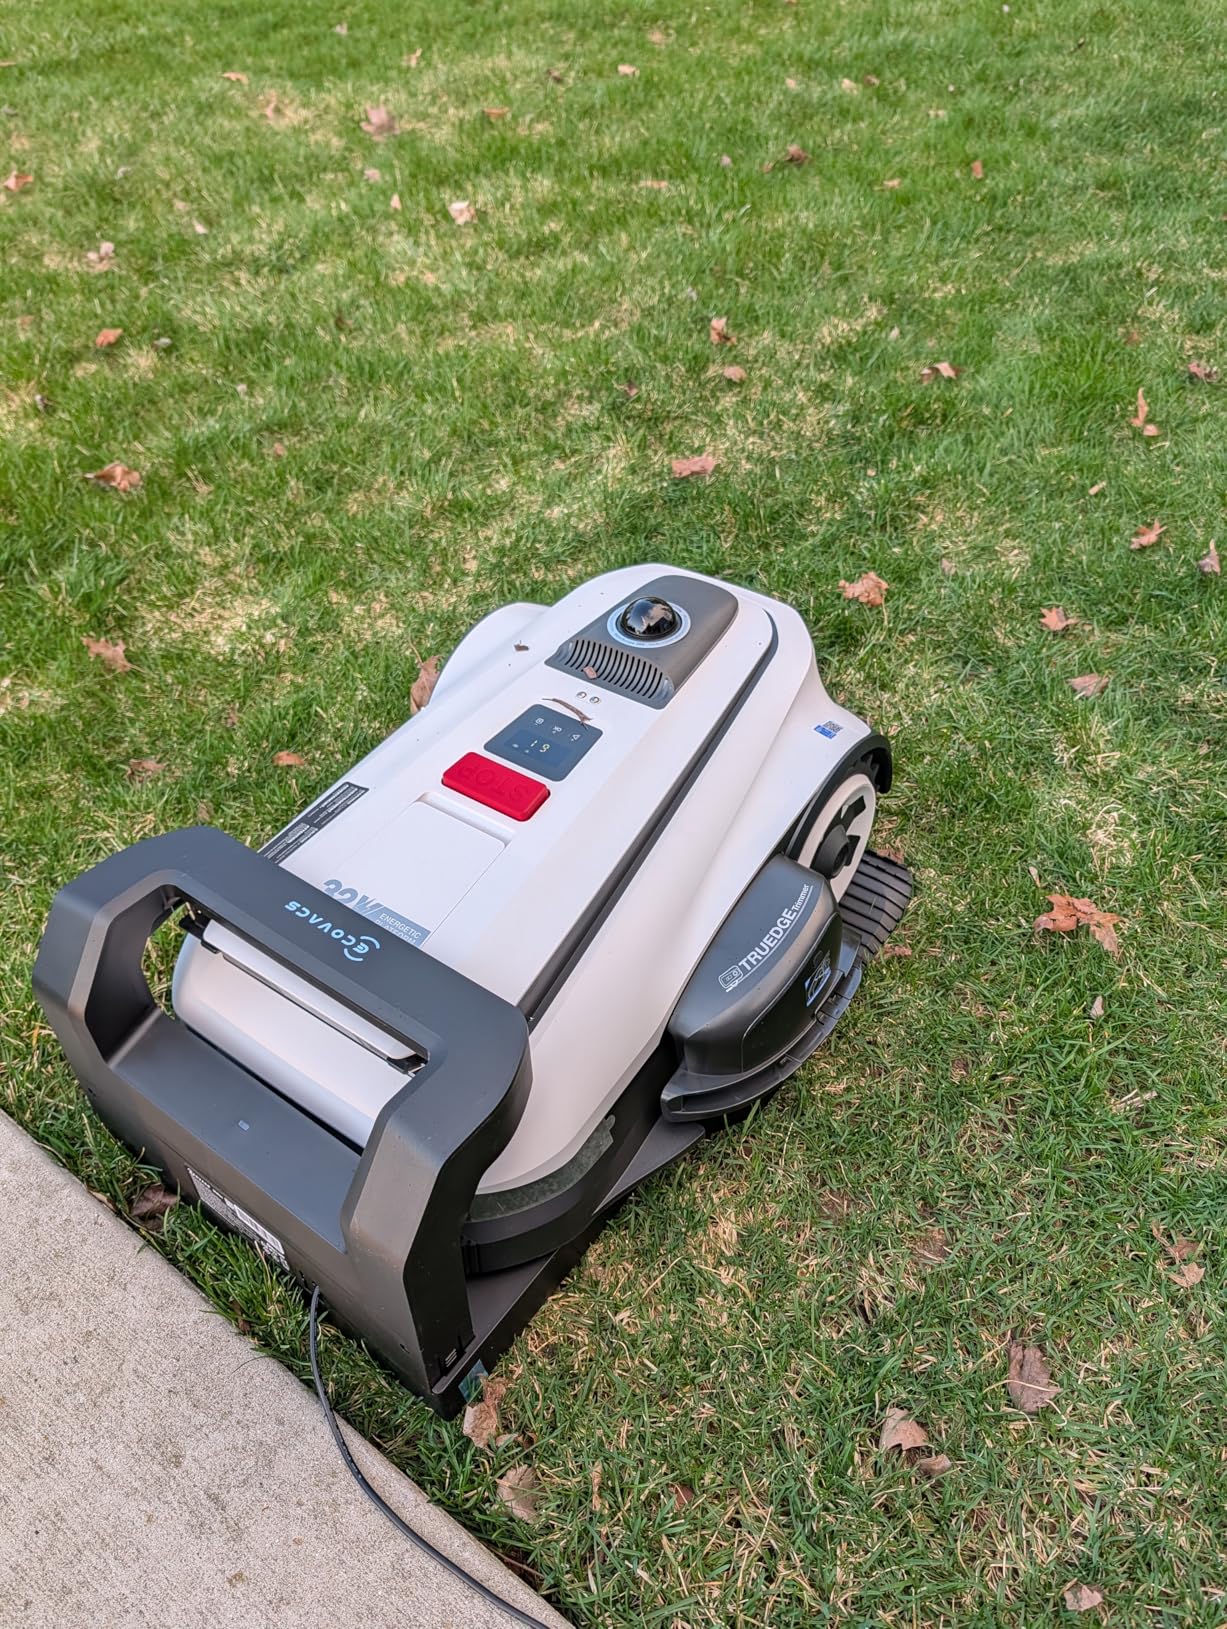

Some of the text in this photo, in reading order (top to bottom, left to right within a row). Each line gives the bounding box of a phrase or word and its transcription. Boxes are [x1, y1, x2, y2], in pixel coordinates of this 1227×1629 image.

[457, 765, 530, 802] STOP
[284, 900, 380, 961] ECOVACS
[379, 913, 422, 939] ENERGETIC
[738, 883, 809, 972] TRUEDGE Trimmer
